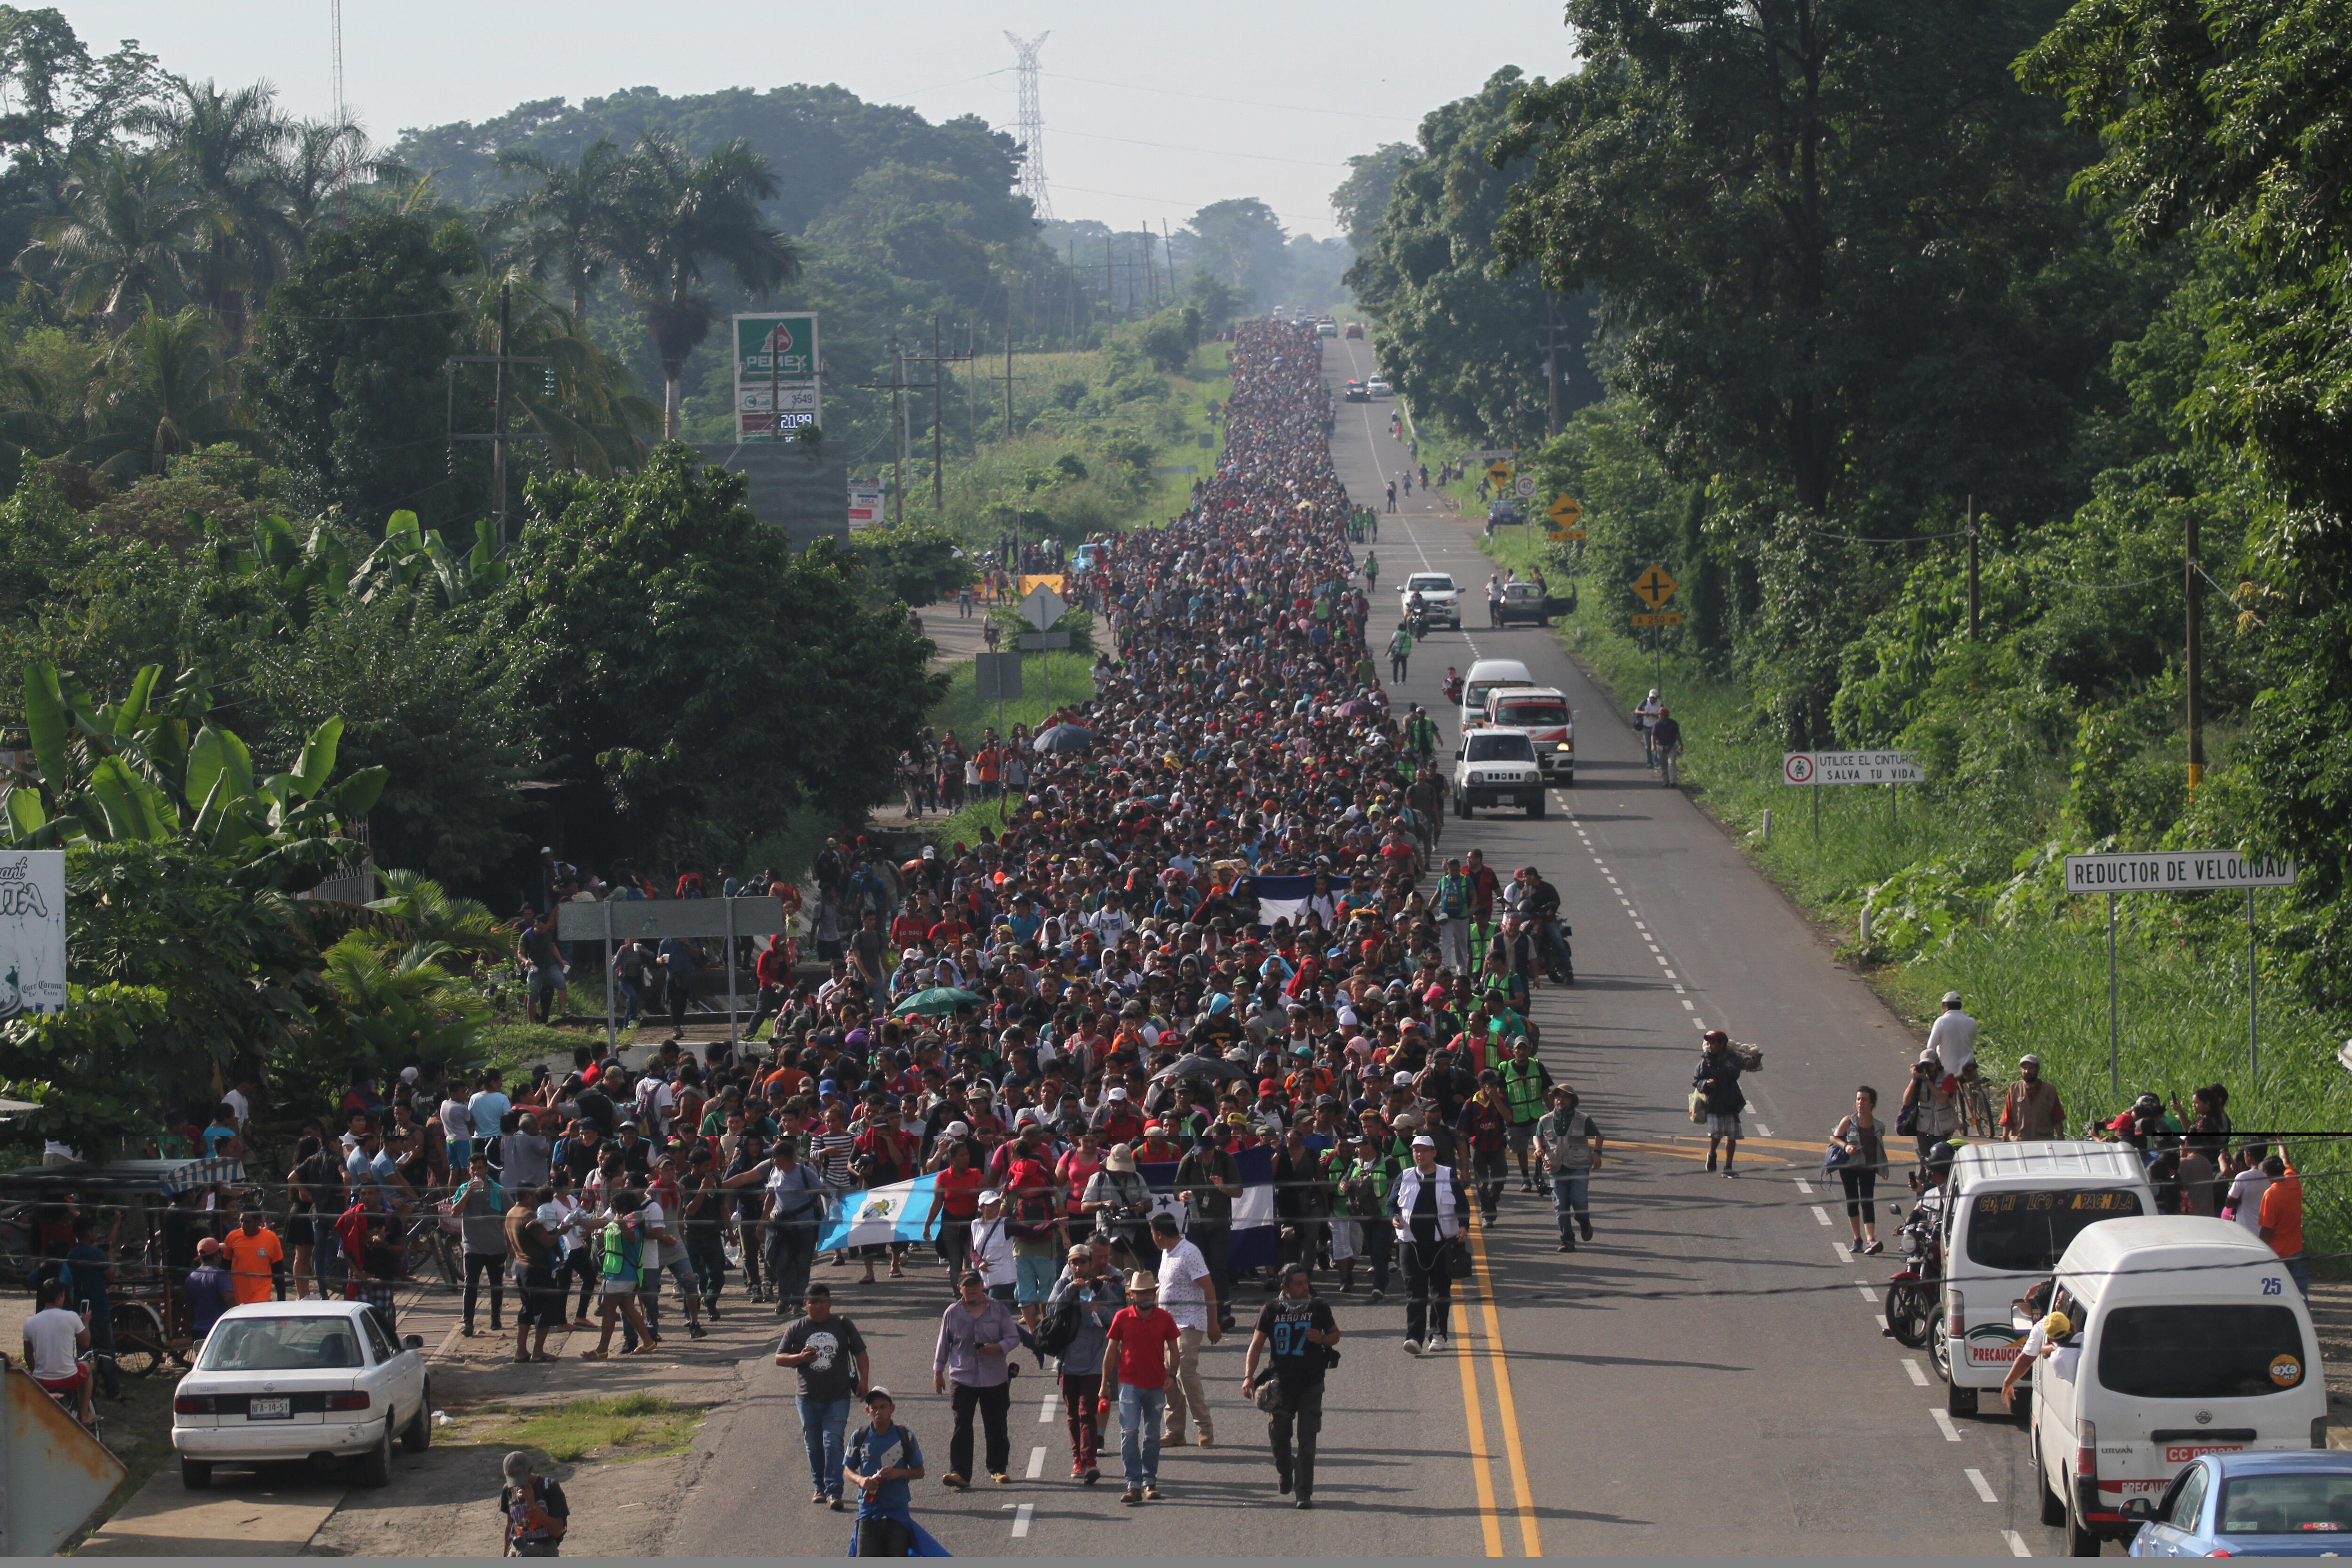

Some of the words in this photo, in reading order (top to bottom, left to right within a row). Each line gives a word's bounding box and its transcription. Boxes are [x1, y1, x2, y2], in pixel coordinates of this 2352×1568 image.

[747, 355, 807, 368] PEMEX
[781, 414, 812, 429] 20.99
[1820, 755, 1854, 766] UTILICE
[1859, 755, 1870, 765] EL
[1827, 770, 1860, 780] SALVA
[1870, 769, 1882, 779] TU
[1891, 769, 1915, 779] VIDA
[0, 857, 27, 879] ant
[2075, 861, 2160, 884] REDUCTOR
[2167, 861, 2187, 881] DE
[2195, 856, 2288, 880] VELOCIDAD
[39, 980, 62, 989] Corona
[2261, 1278, 2281, 1295] 25
[1274, 1322, 1311, 1355] 87
[2272, 1364, 2298, 1376] exa
[252, 1403, 287, 1412] NFA-14-51
[2169, 1449, 2188, 1460] CC
